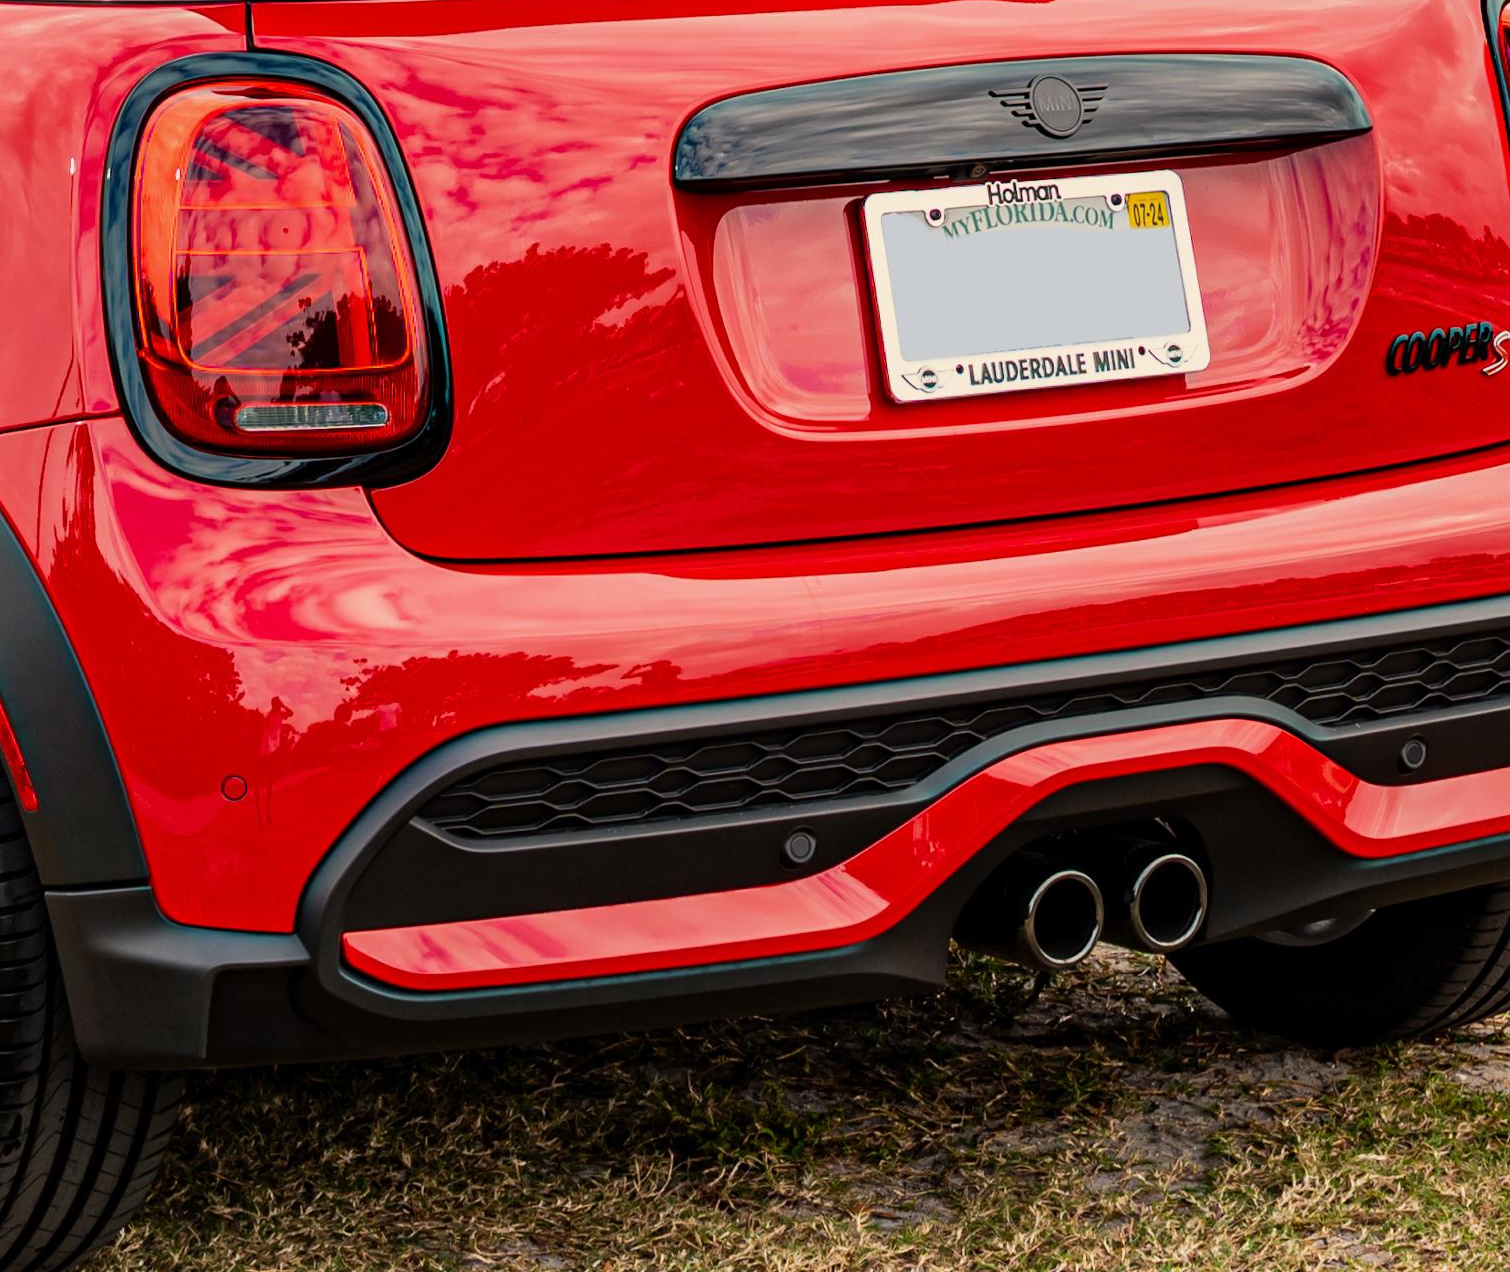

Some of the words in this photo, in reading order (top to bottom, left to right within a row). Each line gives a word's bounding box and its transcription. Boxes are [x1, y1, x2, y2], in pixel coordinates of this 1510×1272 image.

[987, 182, 1062, 206] Holman
[942, 201, 1115, 242] MYFLORIDA.COM
[1133, 202, 1165, 227] 07-24
[967, 353, 1087, 386] LAUDERDALE
[1093, 347, 1136, 374] MINI
[1386, 321, 1493, 376] COOPER
